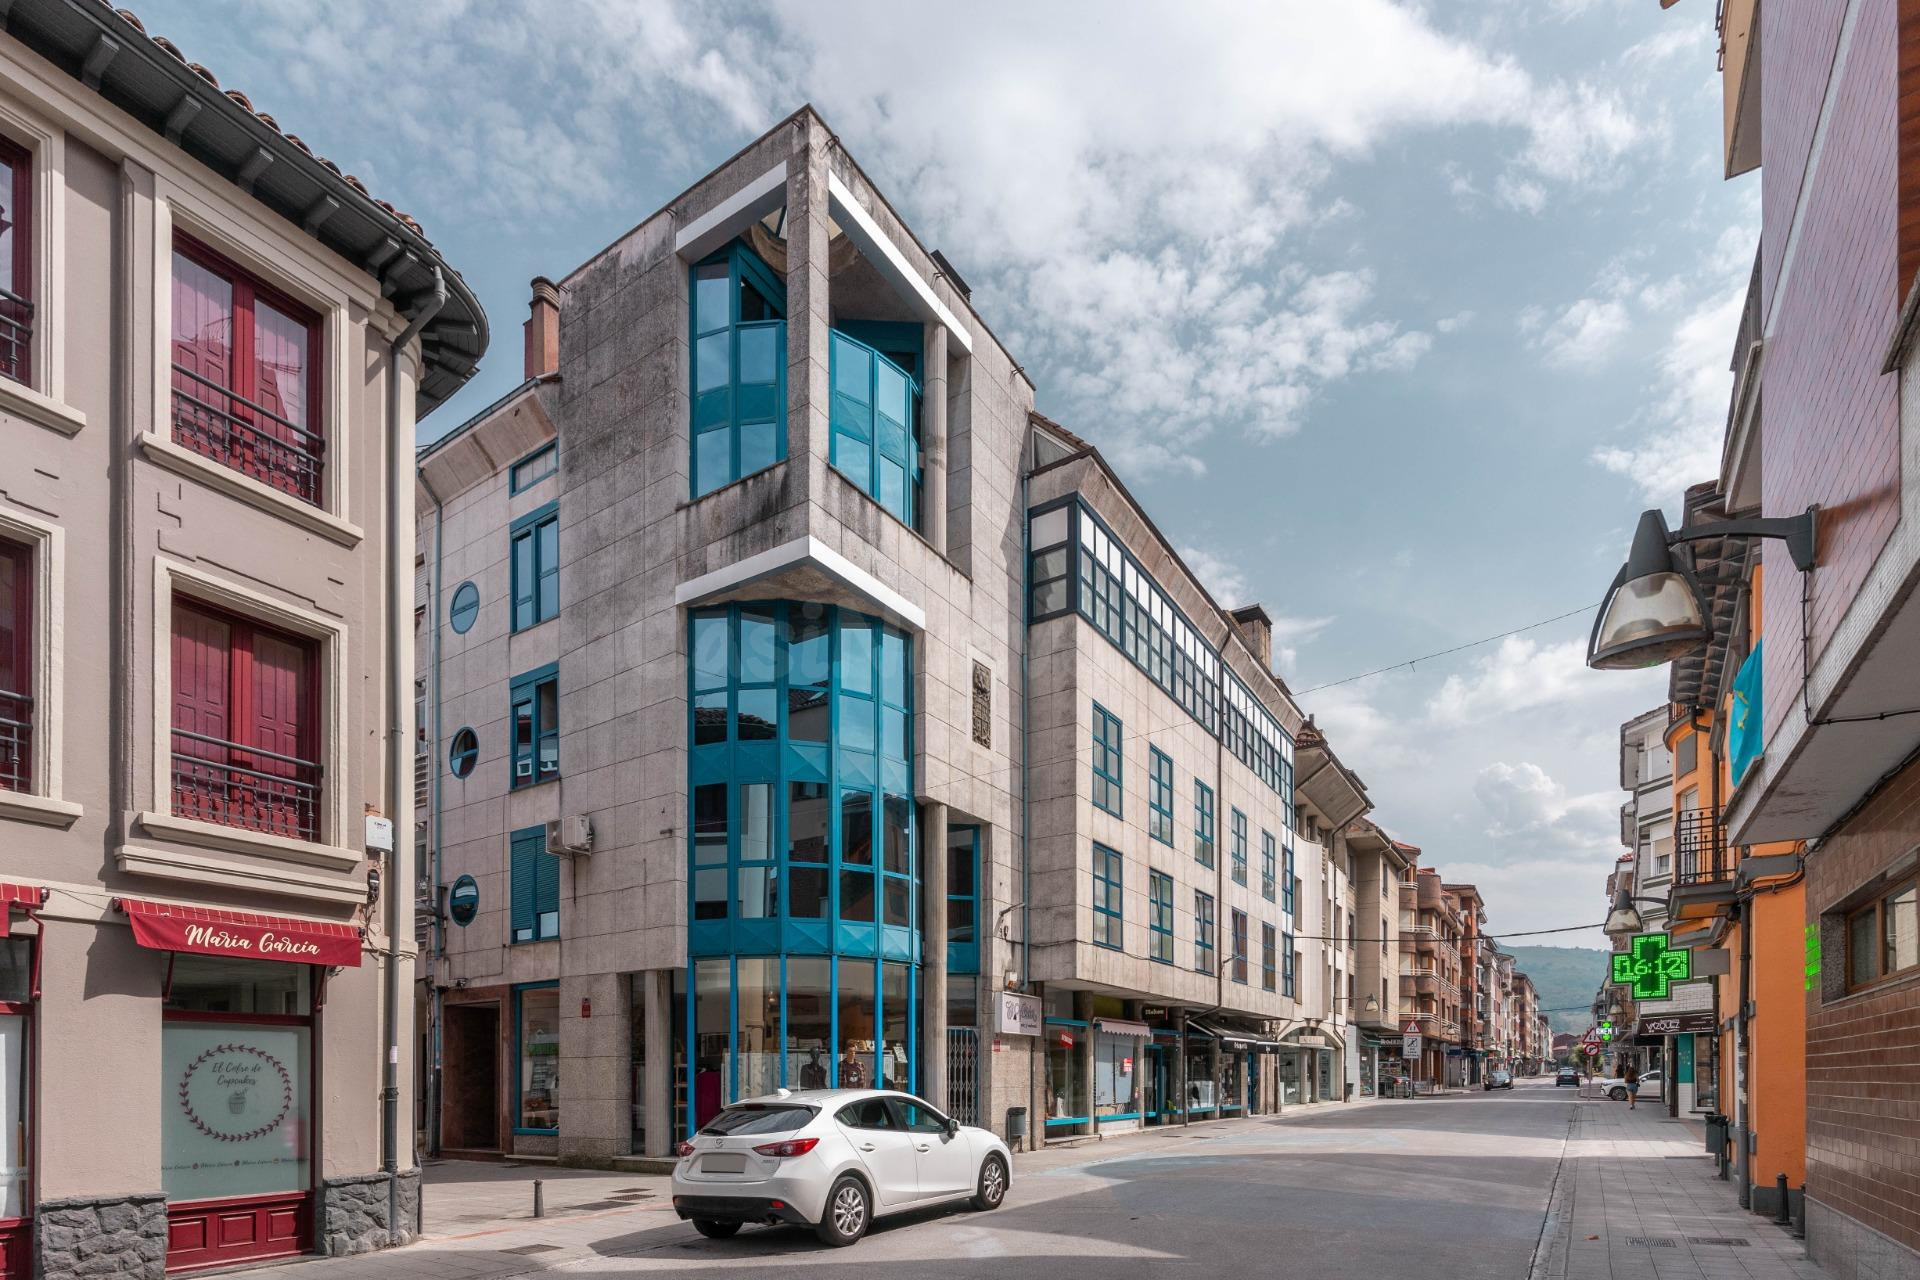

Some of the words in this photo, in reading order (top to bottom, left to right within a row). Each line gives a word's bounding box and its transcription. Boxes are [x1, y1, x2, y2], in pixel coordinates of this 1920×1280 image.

[185, 924, 253, 950] María
[258, 932, 320, 955] García
[1622, 957, 1682, 977] 16:12
